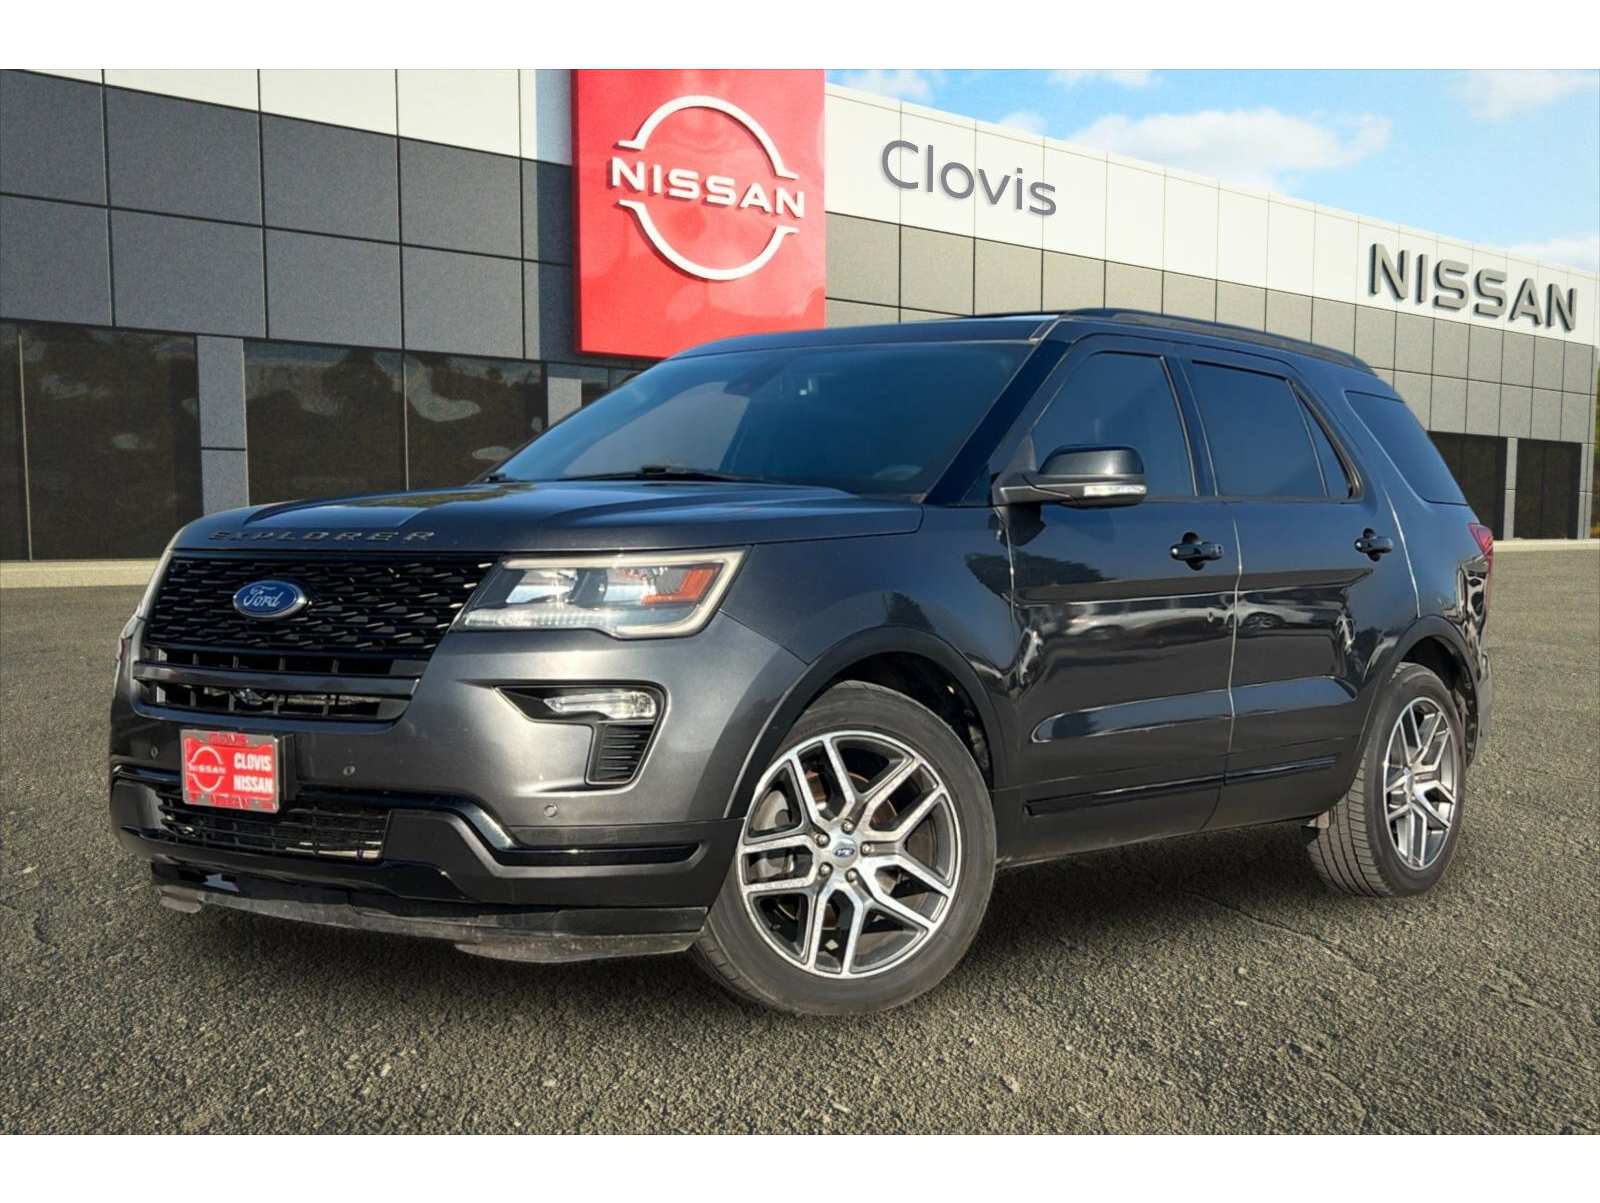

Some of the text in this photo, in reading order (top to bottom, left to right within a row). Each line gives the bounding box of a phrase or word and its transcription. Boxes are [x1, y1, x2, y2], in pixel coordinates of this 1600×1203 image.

[609, 156, 805, 219] NISSAN
[880, 140, 1058, 217] Clovis
[1369, 242, 1578, 332] NISSAN
[207, 529, 437, 542] EXPLORER
[242, 584, 283, 608] Ford
[187, 762, 226, 775] NISSAN
[233, 752, 272, 772] CLOVIS
[233, 774, 273, 794] NISSAN
